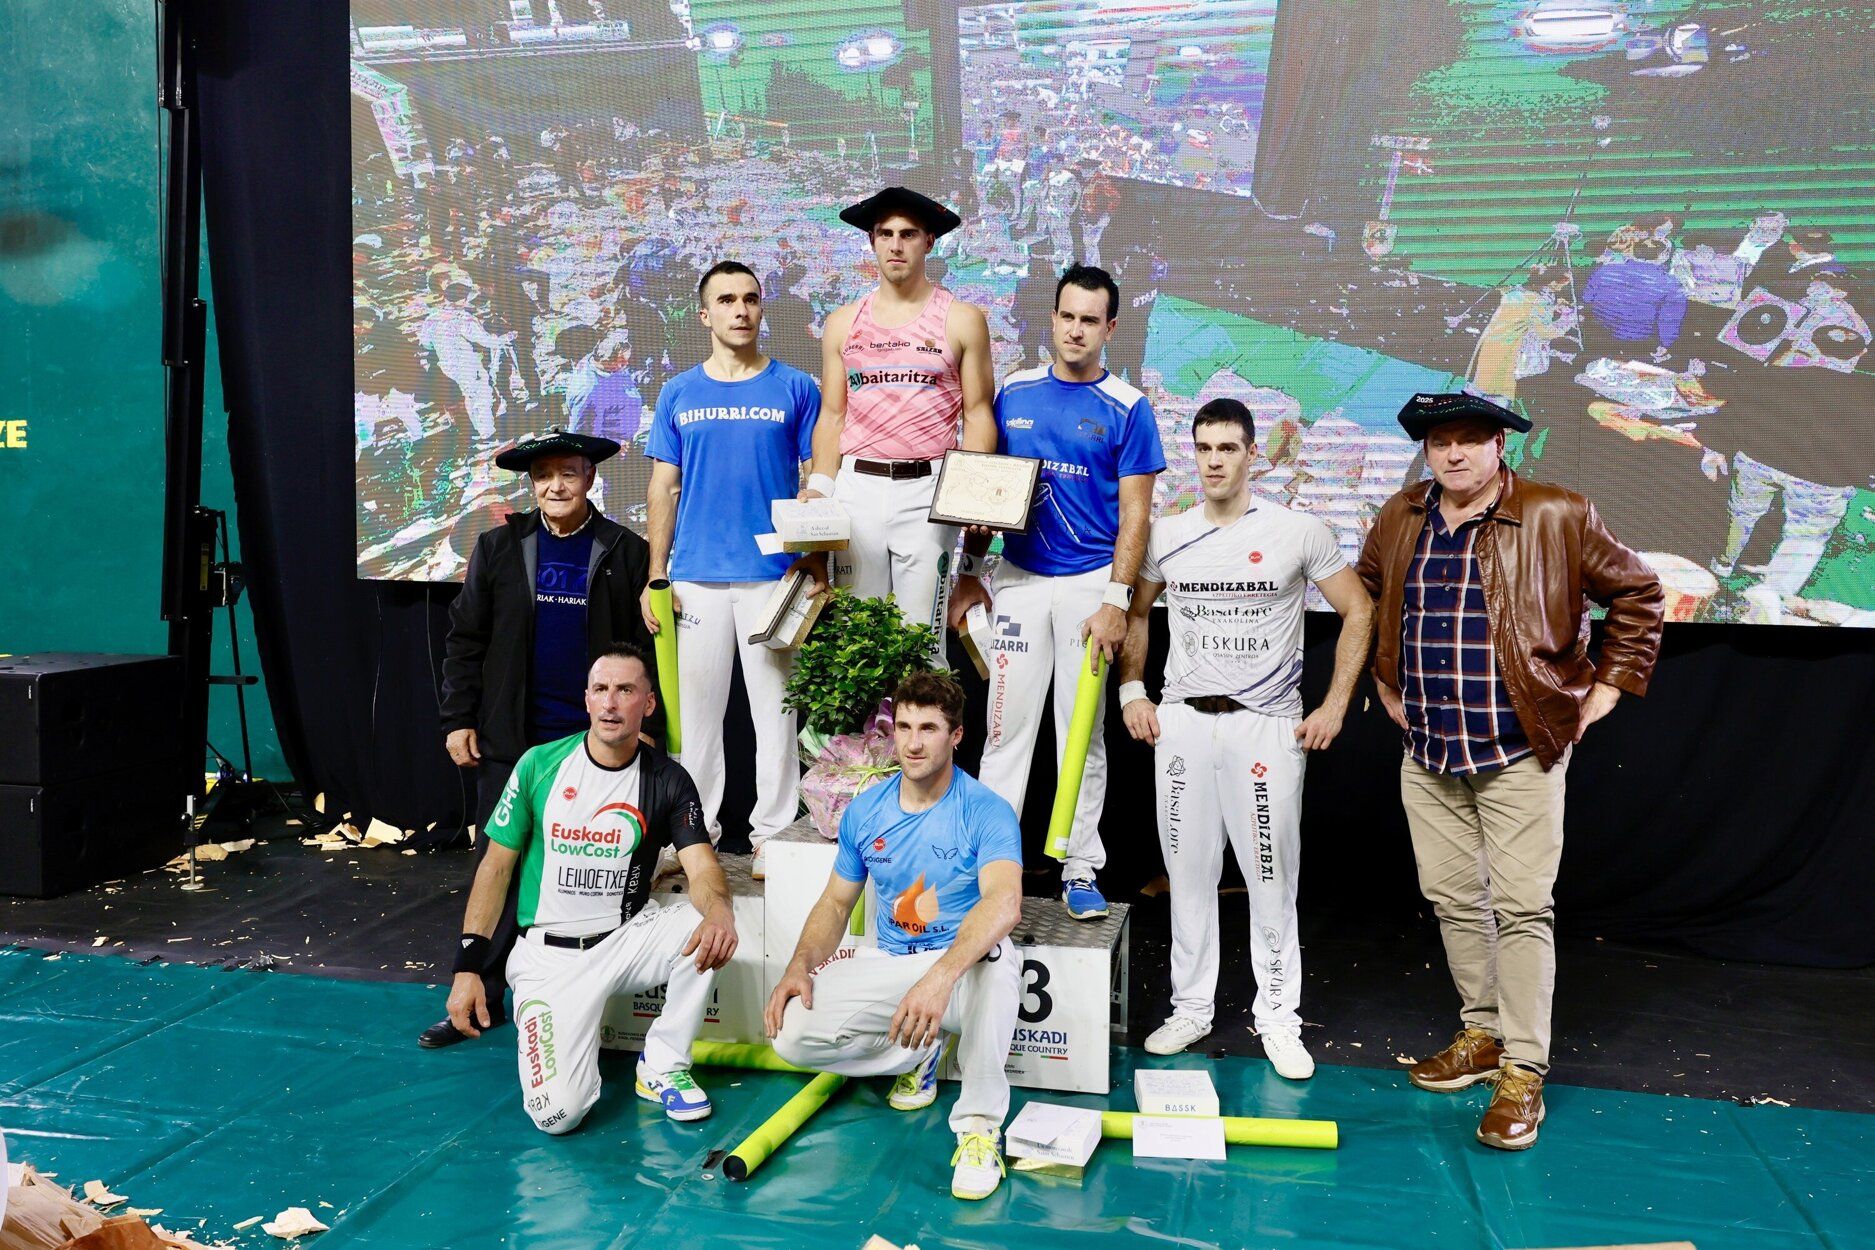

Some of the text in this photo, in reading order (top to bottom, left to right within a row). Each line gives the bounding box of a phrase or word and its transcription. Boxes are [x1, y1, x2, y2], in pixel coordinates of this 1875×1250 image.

[869, 341, 911, 349] bertako
[848, 369, 938, 388] Albaitaritza
[1202, 635, 1270, 651] ESKURA
[551, 822, 622, 845] Euskadi
[551, 840, 621, 859] LowCost
[912, 923, 931, 934] OIL
[1018, 959, 1053, 1023] 3
[525, 1016, 544, 1088] Euskadi
[538, 1010, 558, 1082] LowCost
[1027, 1045, 1068, 1055] COUNTRY
